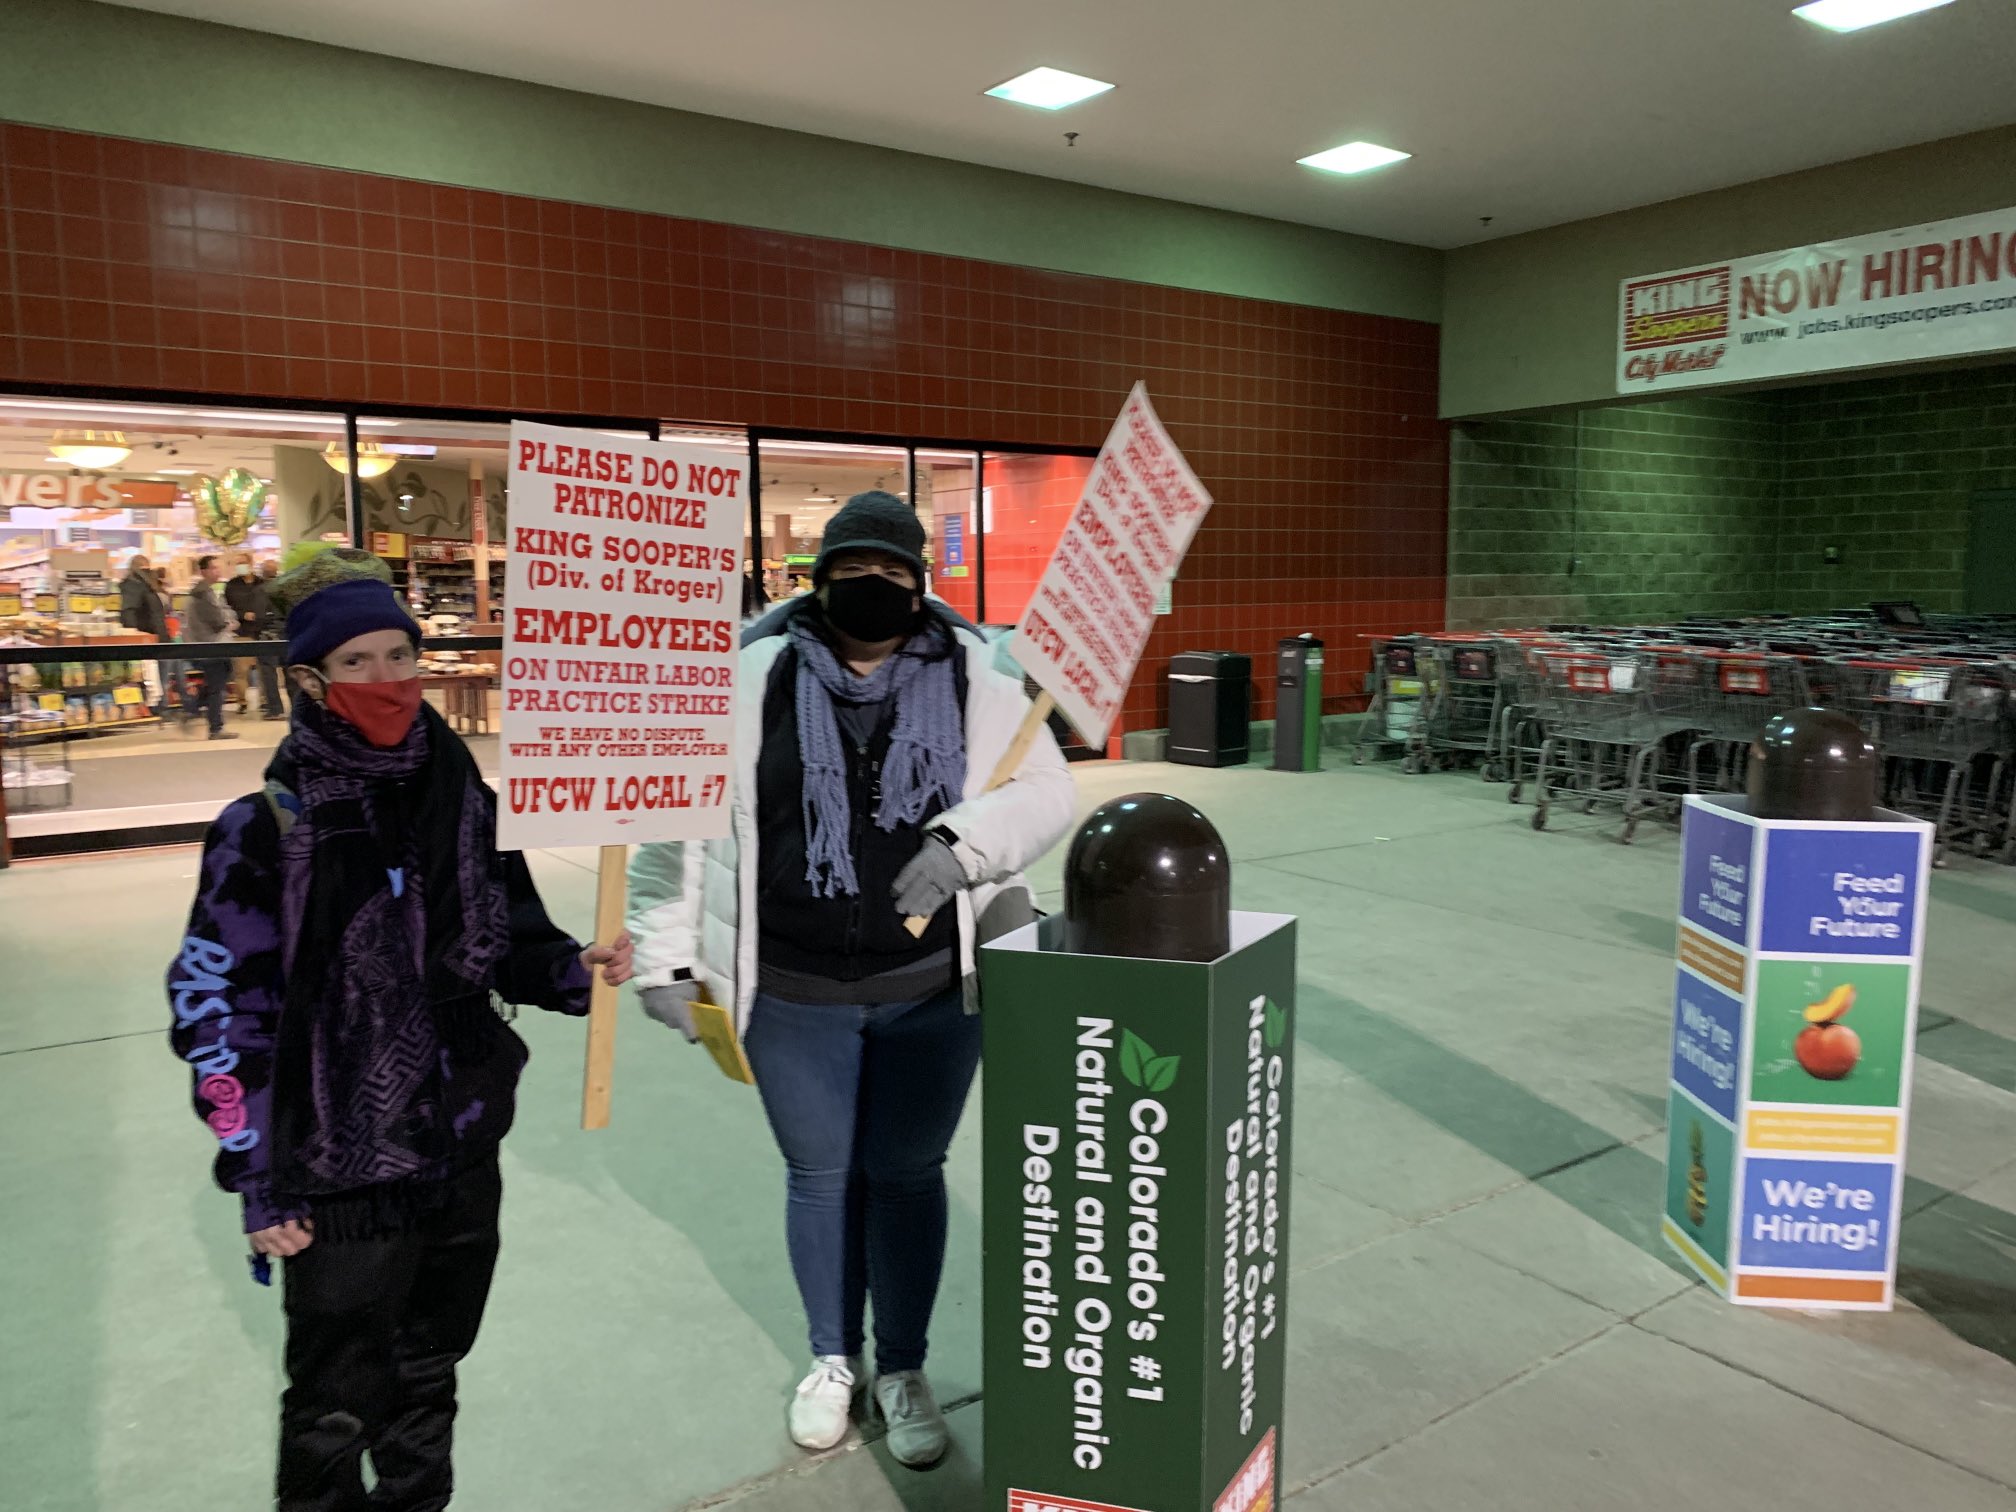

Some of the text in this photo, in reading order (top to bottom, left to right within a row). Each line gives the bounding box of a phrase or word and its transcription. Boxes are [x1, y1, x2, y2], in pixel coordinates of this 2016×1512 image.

[1739, 259, 1848, 320] NOW
[1797, 295, 2016, 340] jobs.kingsoopers.co
[517, 438, 742, 499] PLEASE DO NOT
[553, 481, 707, 530] PATRONIZE
[514, 527, 736, 574] KING SOOPER'S
[528, 560, 725, 604] (Div. of Kroger)
[512, 608, 732, 654] EMPLOYEES
[507, 657, 732, 688] ON UNFAIR LABOR
[507, 688, 730, 716] PRACTICE STRIKE
[510, 742, 728, 758] WITH ANY OTHER EMPLOYER
[540, 727, 705, 742] WE HAVE NO DISPUTE
[508, 774, 728, 816] UFCW LOCAL #7
[1709, 854, 1746, 884] Feed
[1833, 872, 1905, 893] Feed
[1809, 916, 1901, 938] Future
[1838, 896, 1904, 917] Your
[1238, 995, 1266, 1435] Natural and Organic
[1260, 1055, 1284, 1339] Colorado's #1
[1762, 1179, 1875, 1211] We're
[1023, 1124, 1059, 1369] Destination
[1064, 1016, 1113, 1470] Natural and Organic
[1127, 1098, 1168, 1402] Colorado's #1
[1222, 1119, 1245, 1374] Destination
[1753, 1213, 1880, 1251] Hiring!
